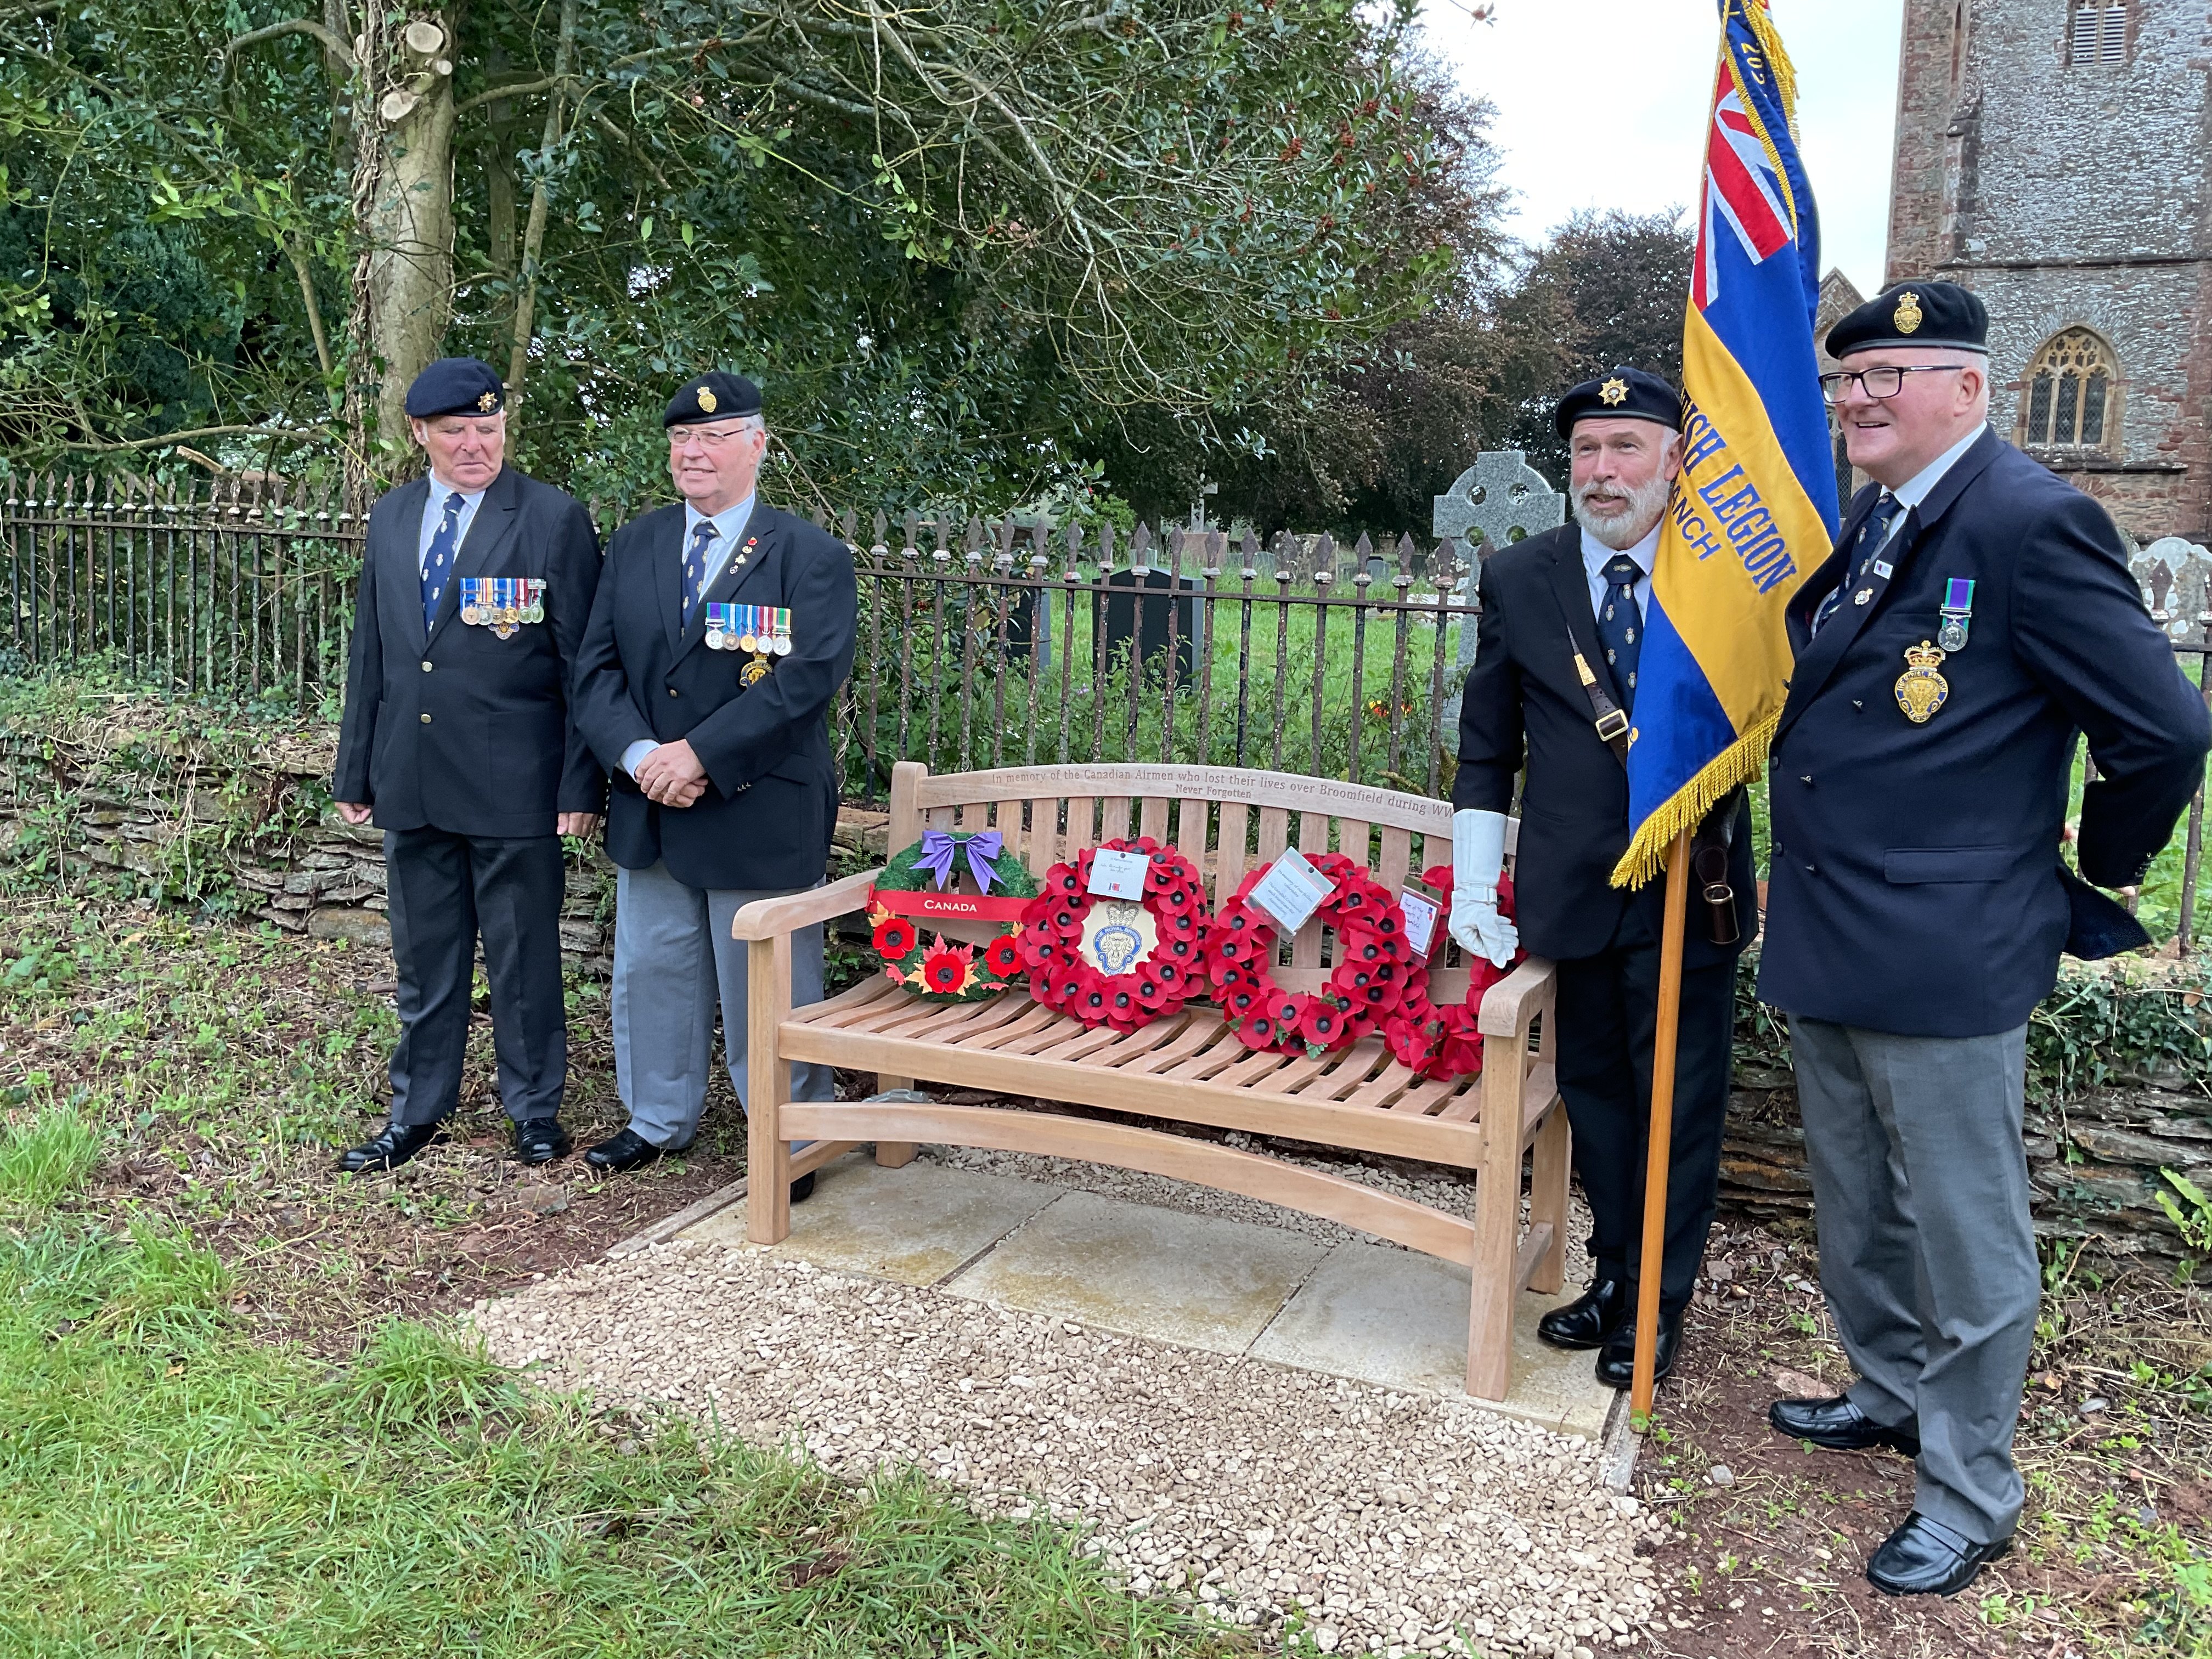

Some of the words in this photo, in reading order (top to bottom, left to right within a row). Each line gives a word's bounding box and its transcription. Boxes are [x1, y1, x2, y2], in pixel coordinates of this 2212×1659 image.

[1698, 464, 1797, 595] LEGION
[992, 774, 1001, 783] In
[1007, 772, 1046, 783] memory
[1050, 770, 1060, 780] of
[1064, 769, 1080, 780] the
[1084, 769, 1131, 780] Canadian
[1135, 769, 1173, 781] Airmen
[1178, 771, 1200, 782] who
[1205, 772, 1225, 783] lost
[1229, 775, 1256, 786] their
[1260, 776, 1286, 789] lives
[1290, 782, 1316, 793] over
[1319, 784, 1383, 804] Broomfield
[1388, 795, 1427, 816] during
[1176, 784, 1203, 794] Never
[1206, 786, 1251, 799] Forgotten
[1095, 930, 1103, 942] THE
